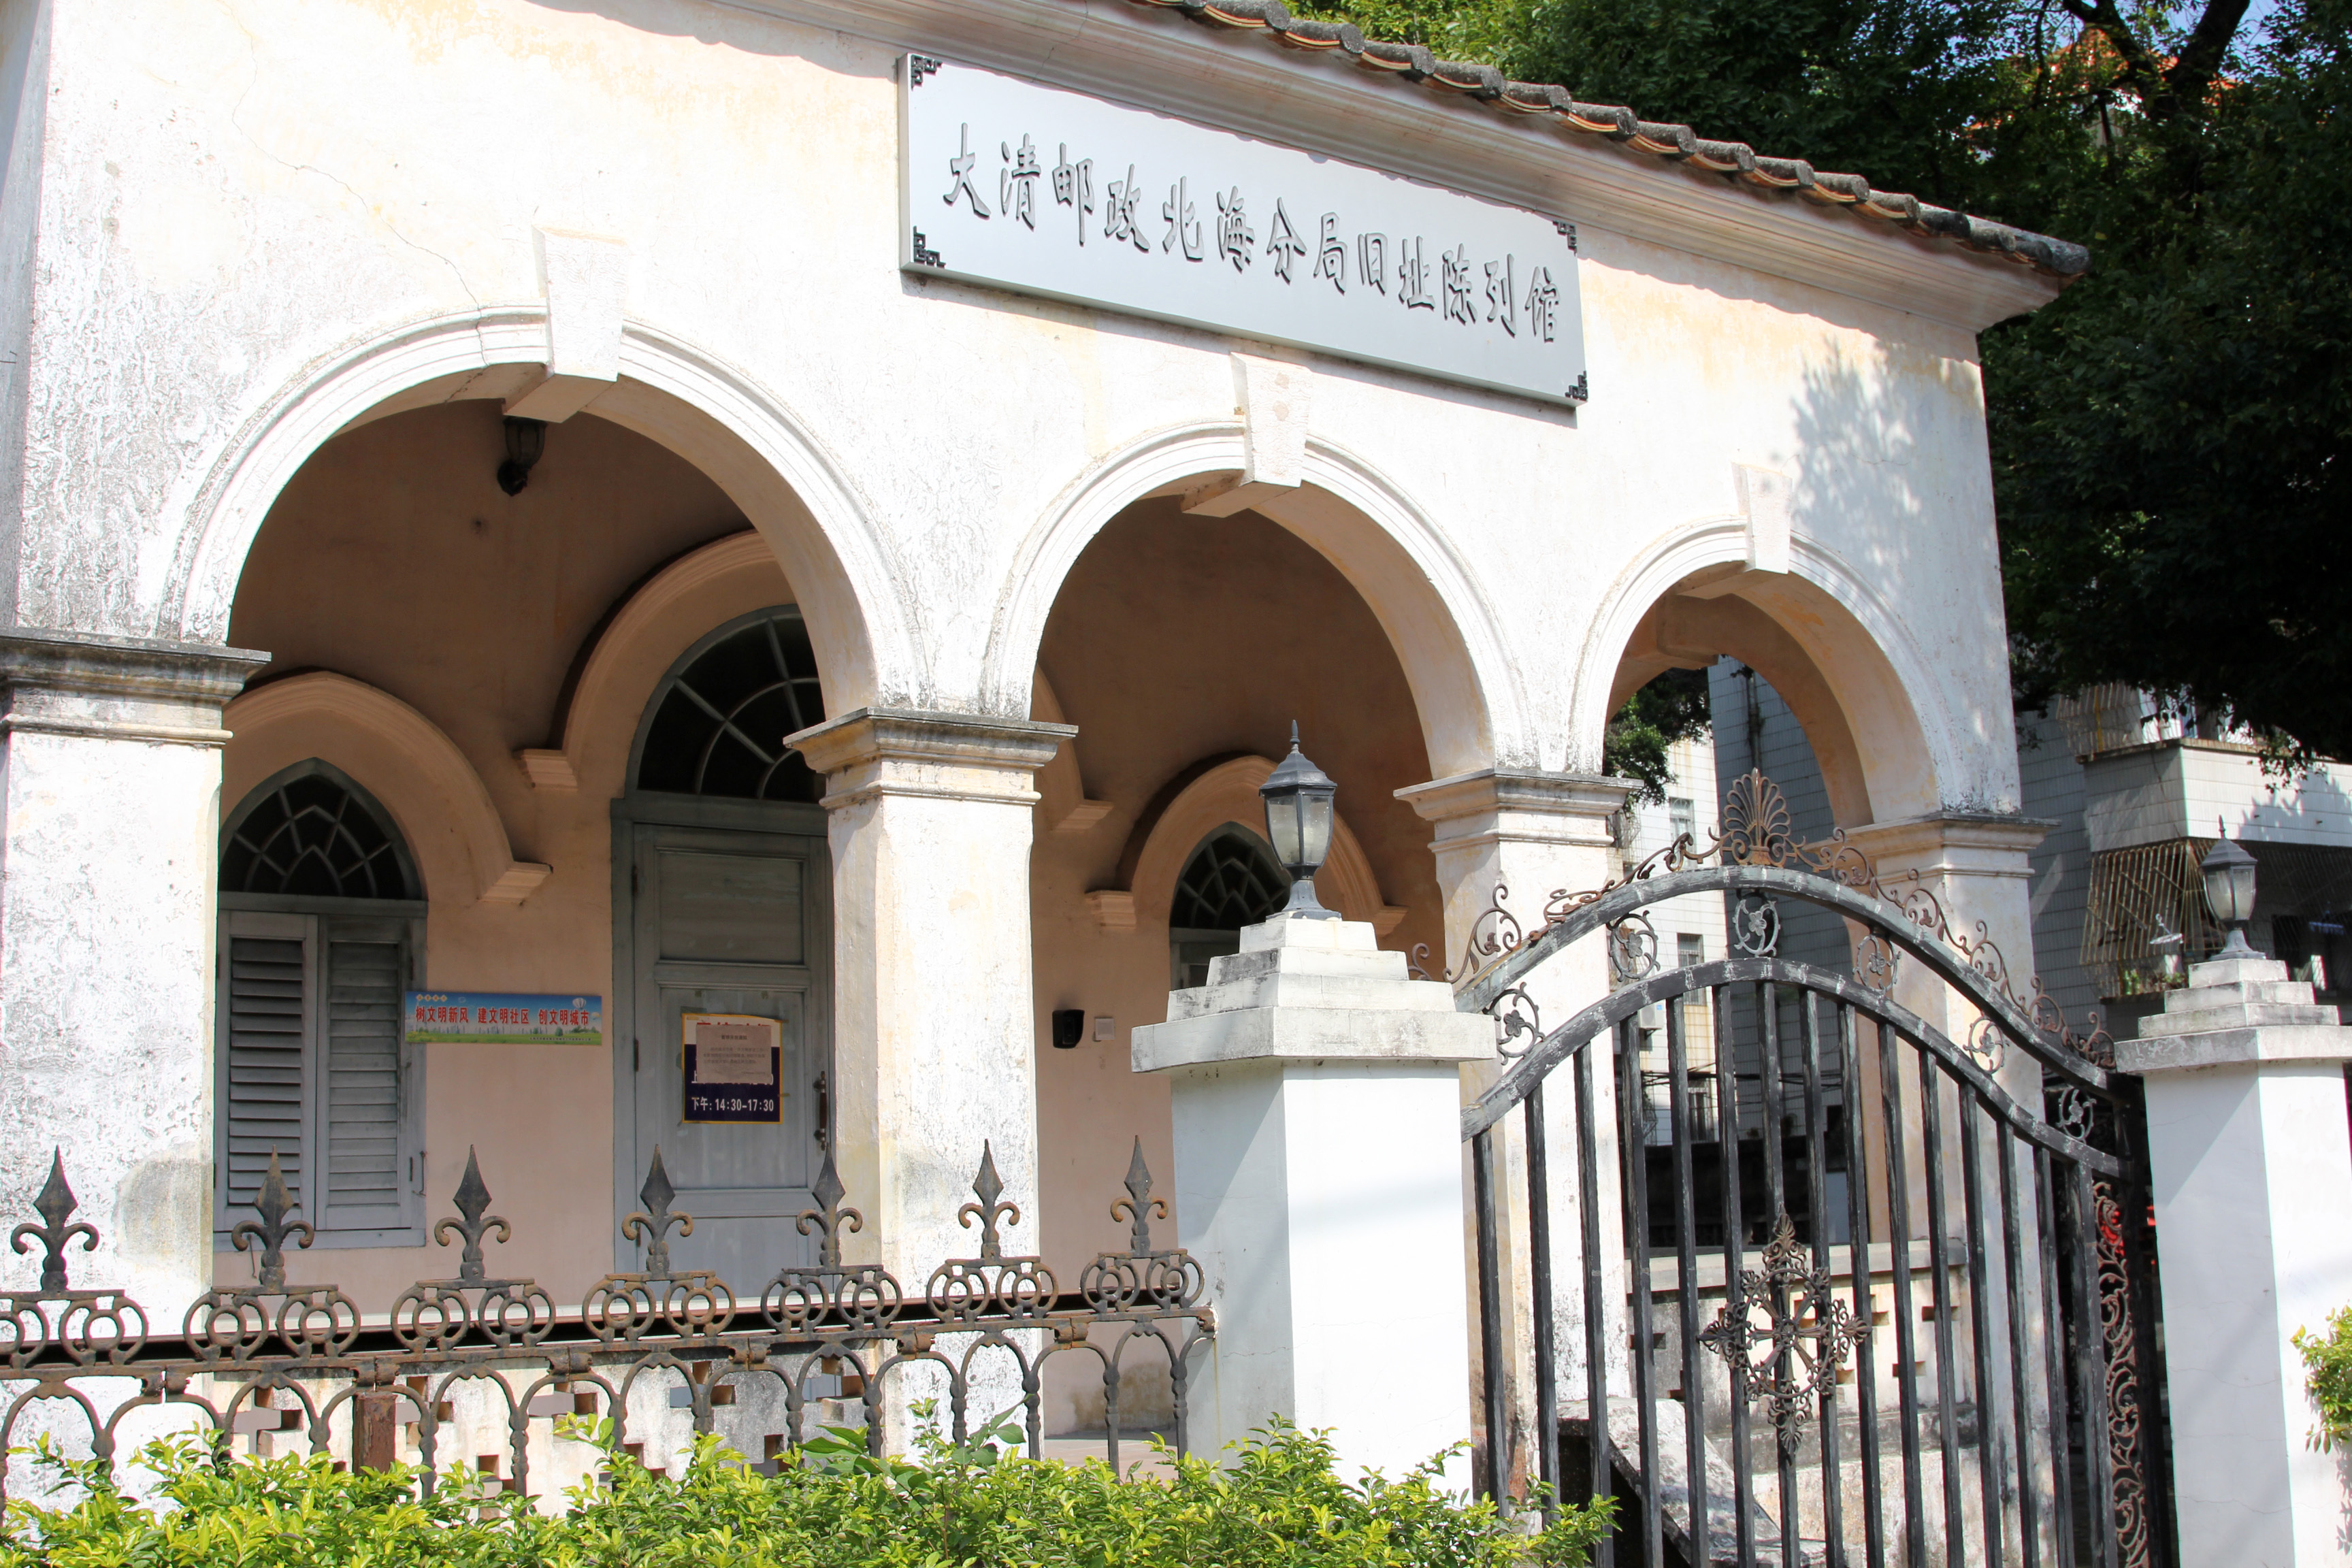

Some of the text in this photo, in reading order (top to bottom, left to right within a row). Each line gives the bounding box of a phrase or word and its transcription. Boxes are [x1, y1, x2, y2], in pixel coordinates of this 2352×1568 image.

[943, 122, 1561, 342] 大清邮政北海分局旧址陈列馆
[415, 1006, 589, 1026] 树文明新风 建文明社区 创文明城市
